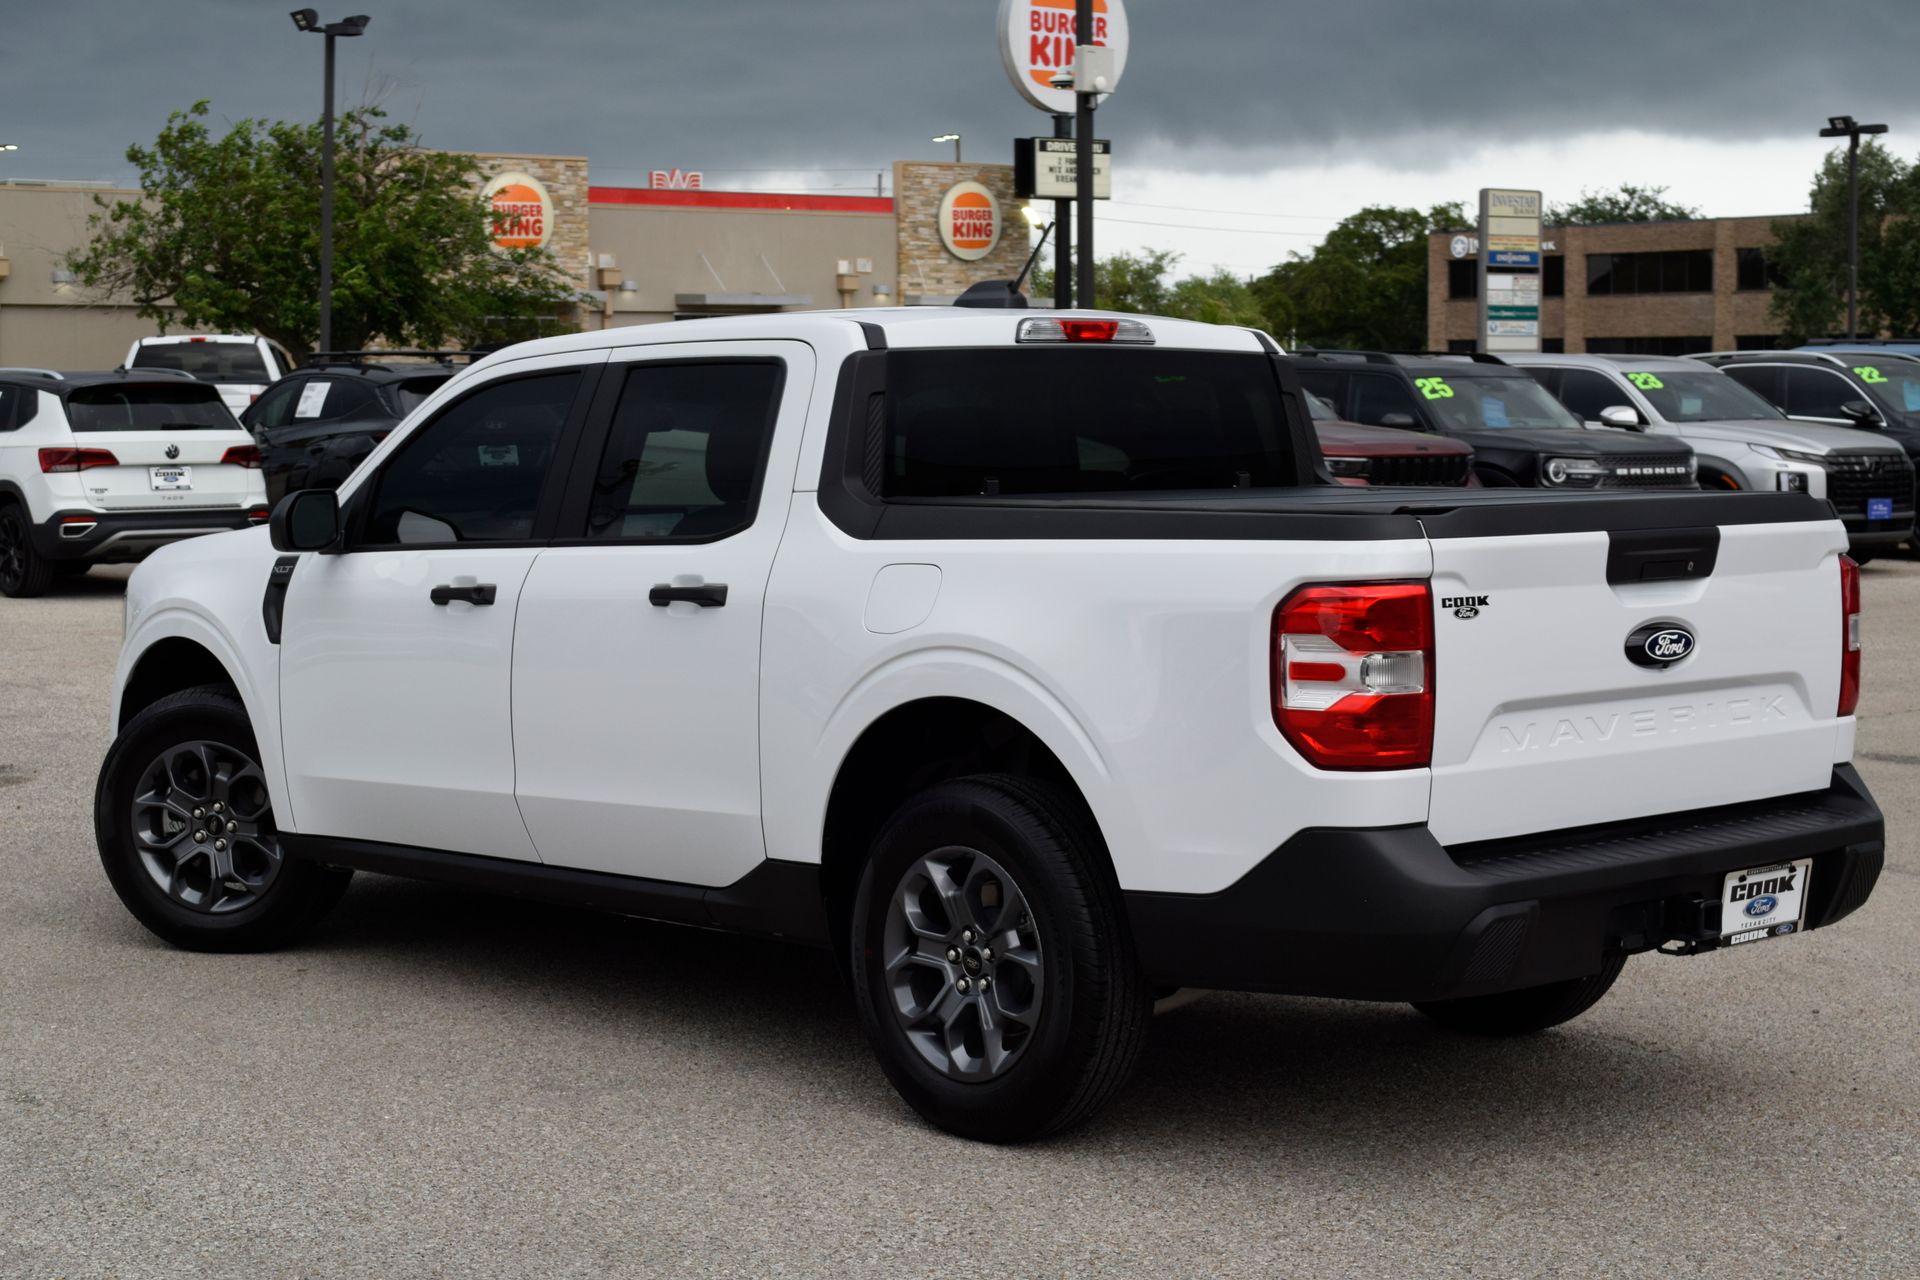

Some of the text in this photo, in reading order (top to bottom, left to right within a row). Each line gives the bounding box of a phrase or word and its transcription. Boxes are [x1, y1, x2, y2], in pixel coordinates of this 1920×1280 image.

[1030, 10, 1107, 38] BURR
[1046, 141, 1076, 152] DRIVE
[952, 210, 992, 220] BURGER
[953, 222, 992, 238] KING
[1415, 377, 1454, 400] 25
[1616, 466, 1685, 475] BRONCO
[274, 565, 294, 573] XLT
[1441, 595, 1489, 608] COOK
[1655, 634, 1684, 656] Ford
[1500, 695, 1787, 752] MAVERICK
[1730, 874, 1797, 902] COOK
[1750, 900, 1771, 914] Ford
[1731, 928, 1769, 945] COOK
